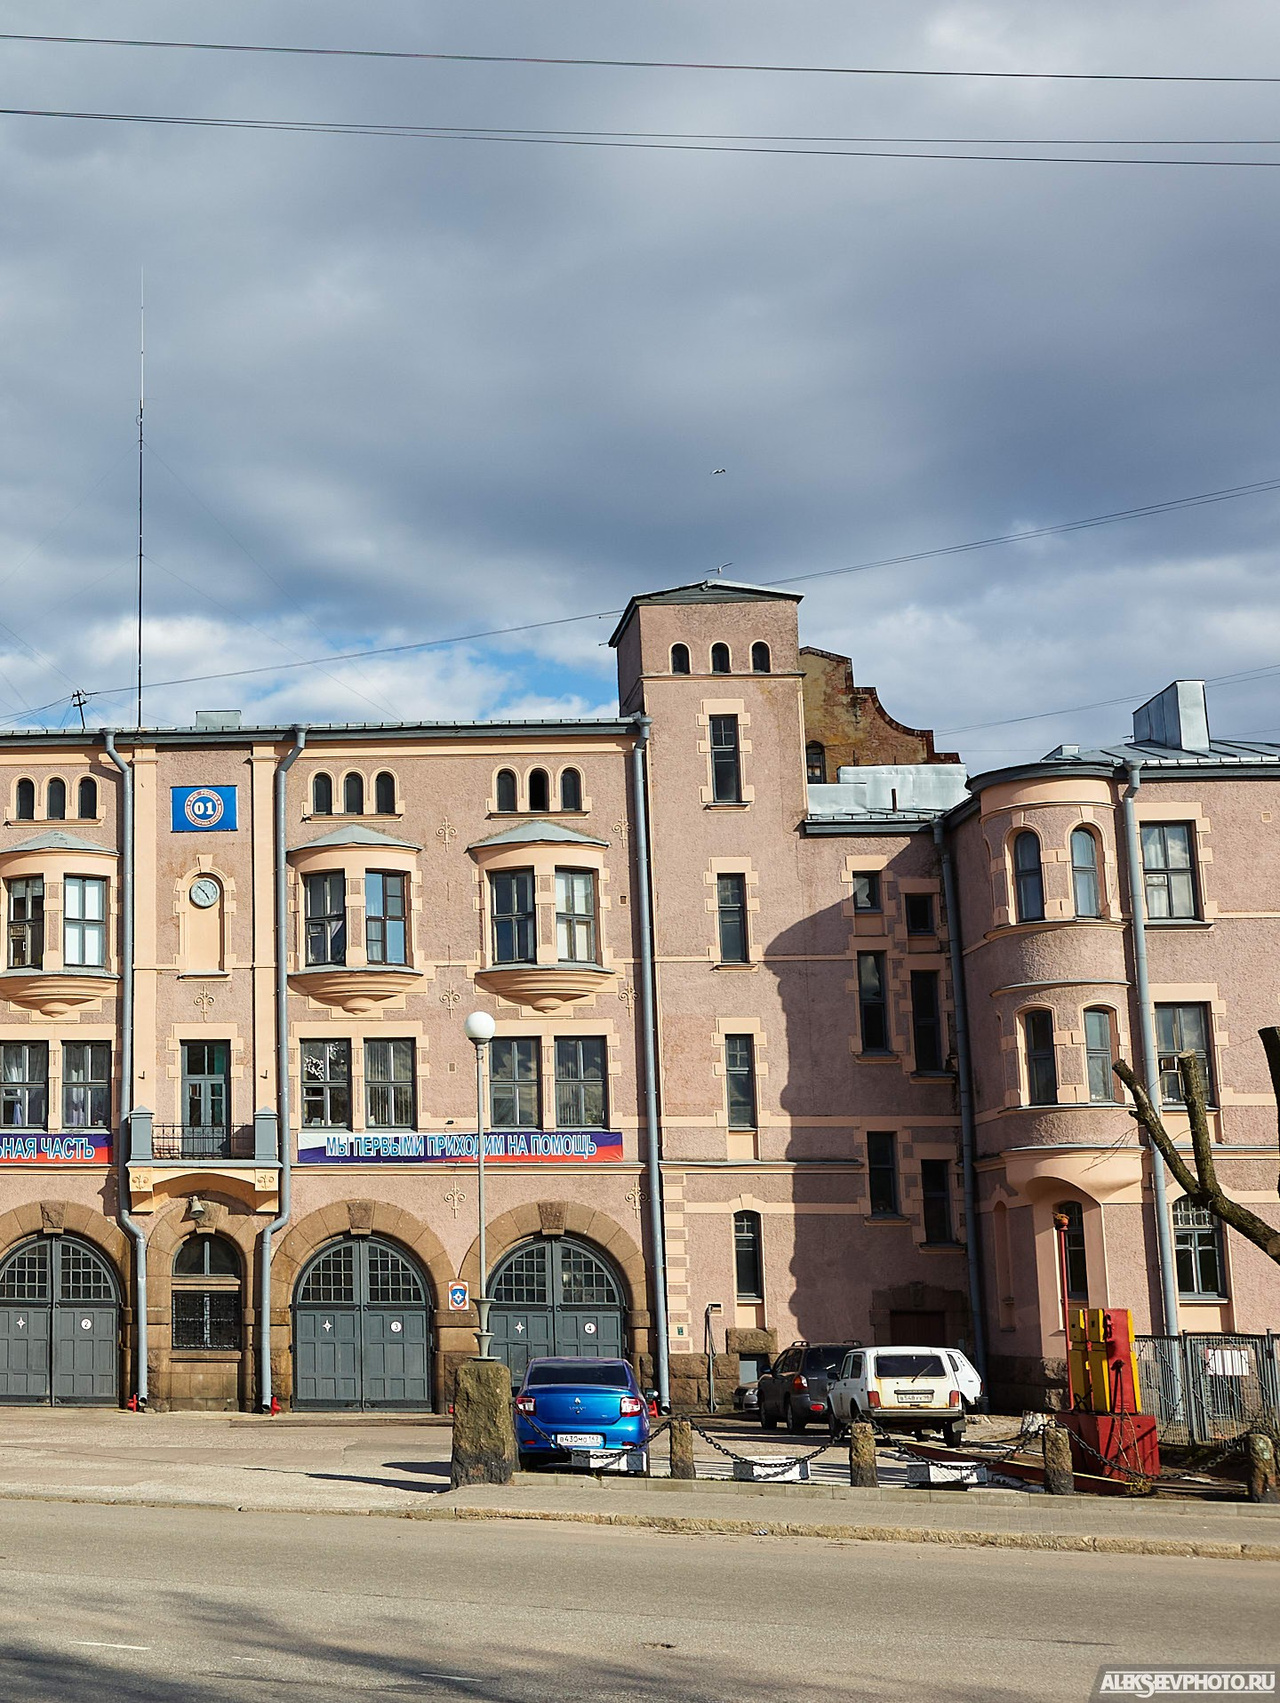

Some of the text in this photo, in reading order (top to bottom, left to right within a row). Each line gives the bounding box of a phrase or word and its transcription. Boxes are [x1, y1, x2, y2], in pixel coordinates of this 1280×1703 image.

[193, 801, 215, 815] 01
[40, 1137, 96, 1159] ЧАСТЬ
[353, 1136, 424, 1157] ПЕРВЫМИ
[507, 1134, 529, 1156] НА
[530, 1134, 597, 1159] ПОМОЩЬ
